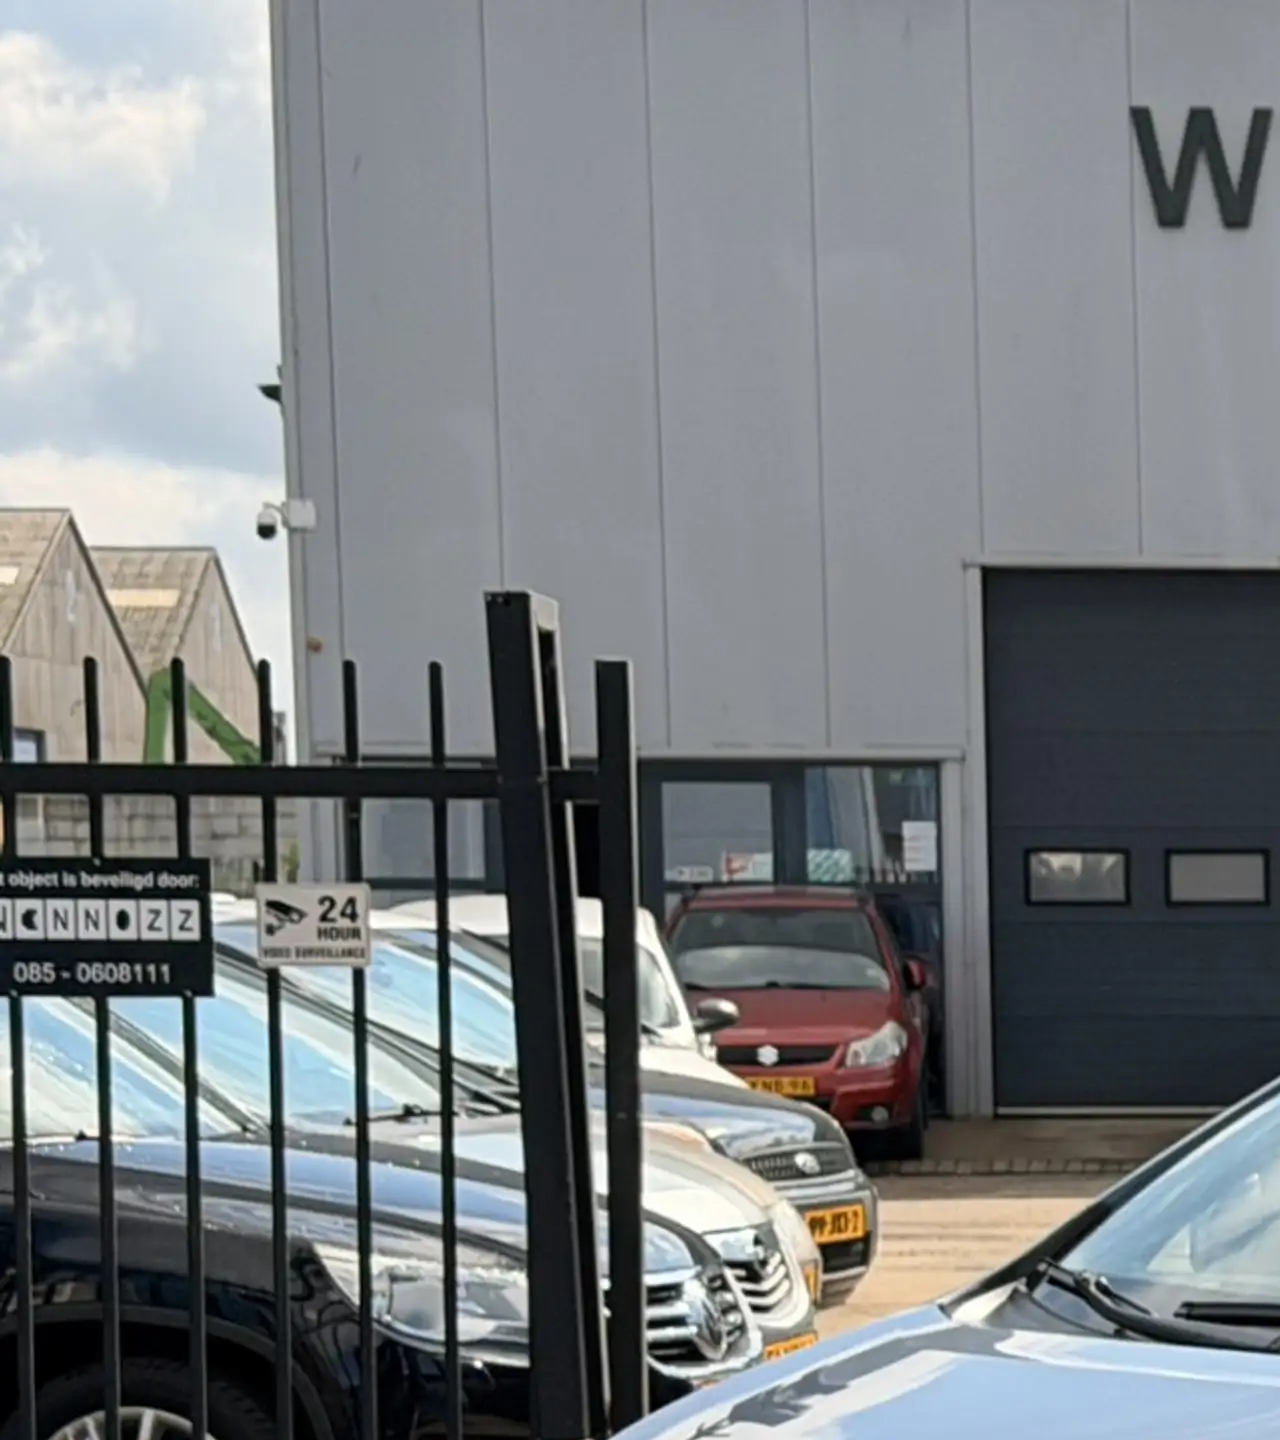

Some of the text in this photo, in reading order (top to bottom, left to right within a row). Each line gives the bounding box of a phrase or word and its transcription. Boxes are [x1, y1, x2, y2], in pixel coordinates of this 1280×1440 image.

[8, 871, 58, 890] object
[63, 871, 77, 888] is
[81, 871, 153, 891] beveiligd
[317, 895, 359, 923] 24
[317, 926, 361, 940] HOUR
[13, 962, 56, 984] 085
[76, 962, 171, 984] 0608111
